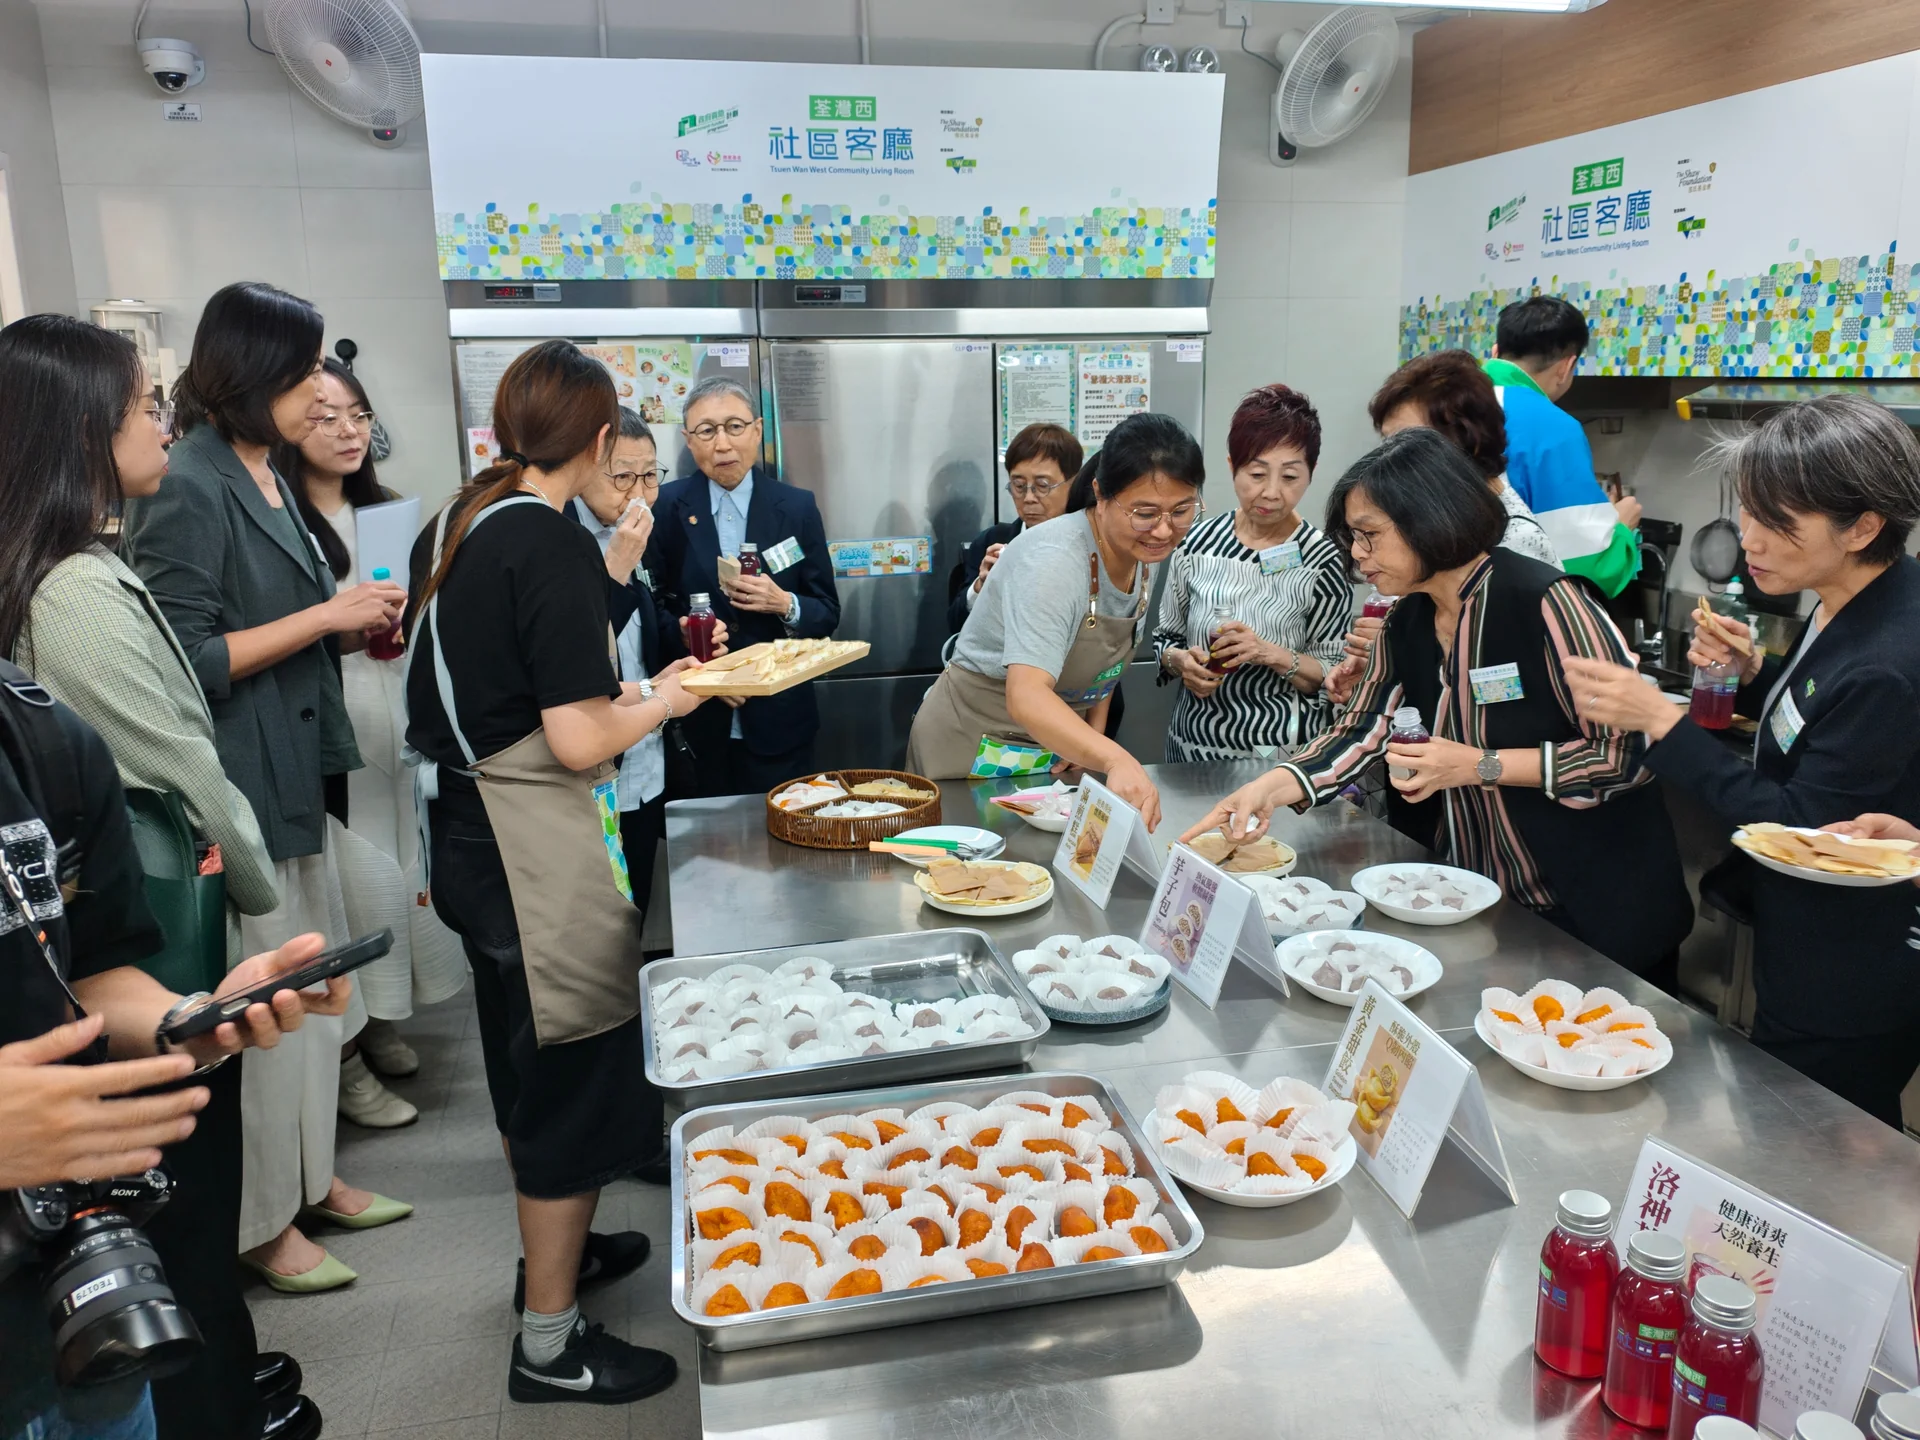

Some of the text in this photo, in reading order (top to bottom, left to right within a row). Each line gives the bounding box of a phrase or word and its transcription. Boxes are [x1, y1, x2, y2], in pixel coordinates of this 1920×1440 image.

[814, 98, 872, 118] 荃灣西
[768, 126, 914, 161] 社區客廳
[770, 165, 791, 173] Tsuen
[792, 165, 808, 173] Wan
[810, 166, 827, 174] West
[828, 167, 870, 176] Community
[871, 168, 893, 176] Living
[1575, 162, 1621, 191] 荃灣西
[1678, 175, 1712, 187] Foundation
[1541, 189, 1652, 244] 社區客廳
[1580, 244, 1612, 254] Community
[1613, 242, 1631, 250] Living
[1159, 856, 1186, 918] 芋子包
[1339, 994, 1377, 1076] 黃金甜餃
[110, 1188, 140, 1196] SONY
[1718, 1198, 1788, 1248] 健康清爽
[1710, 1218, 1780, 1268] 天然養生
